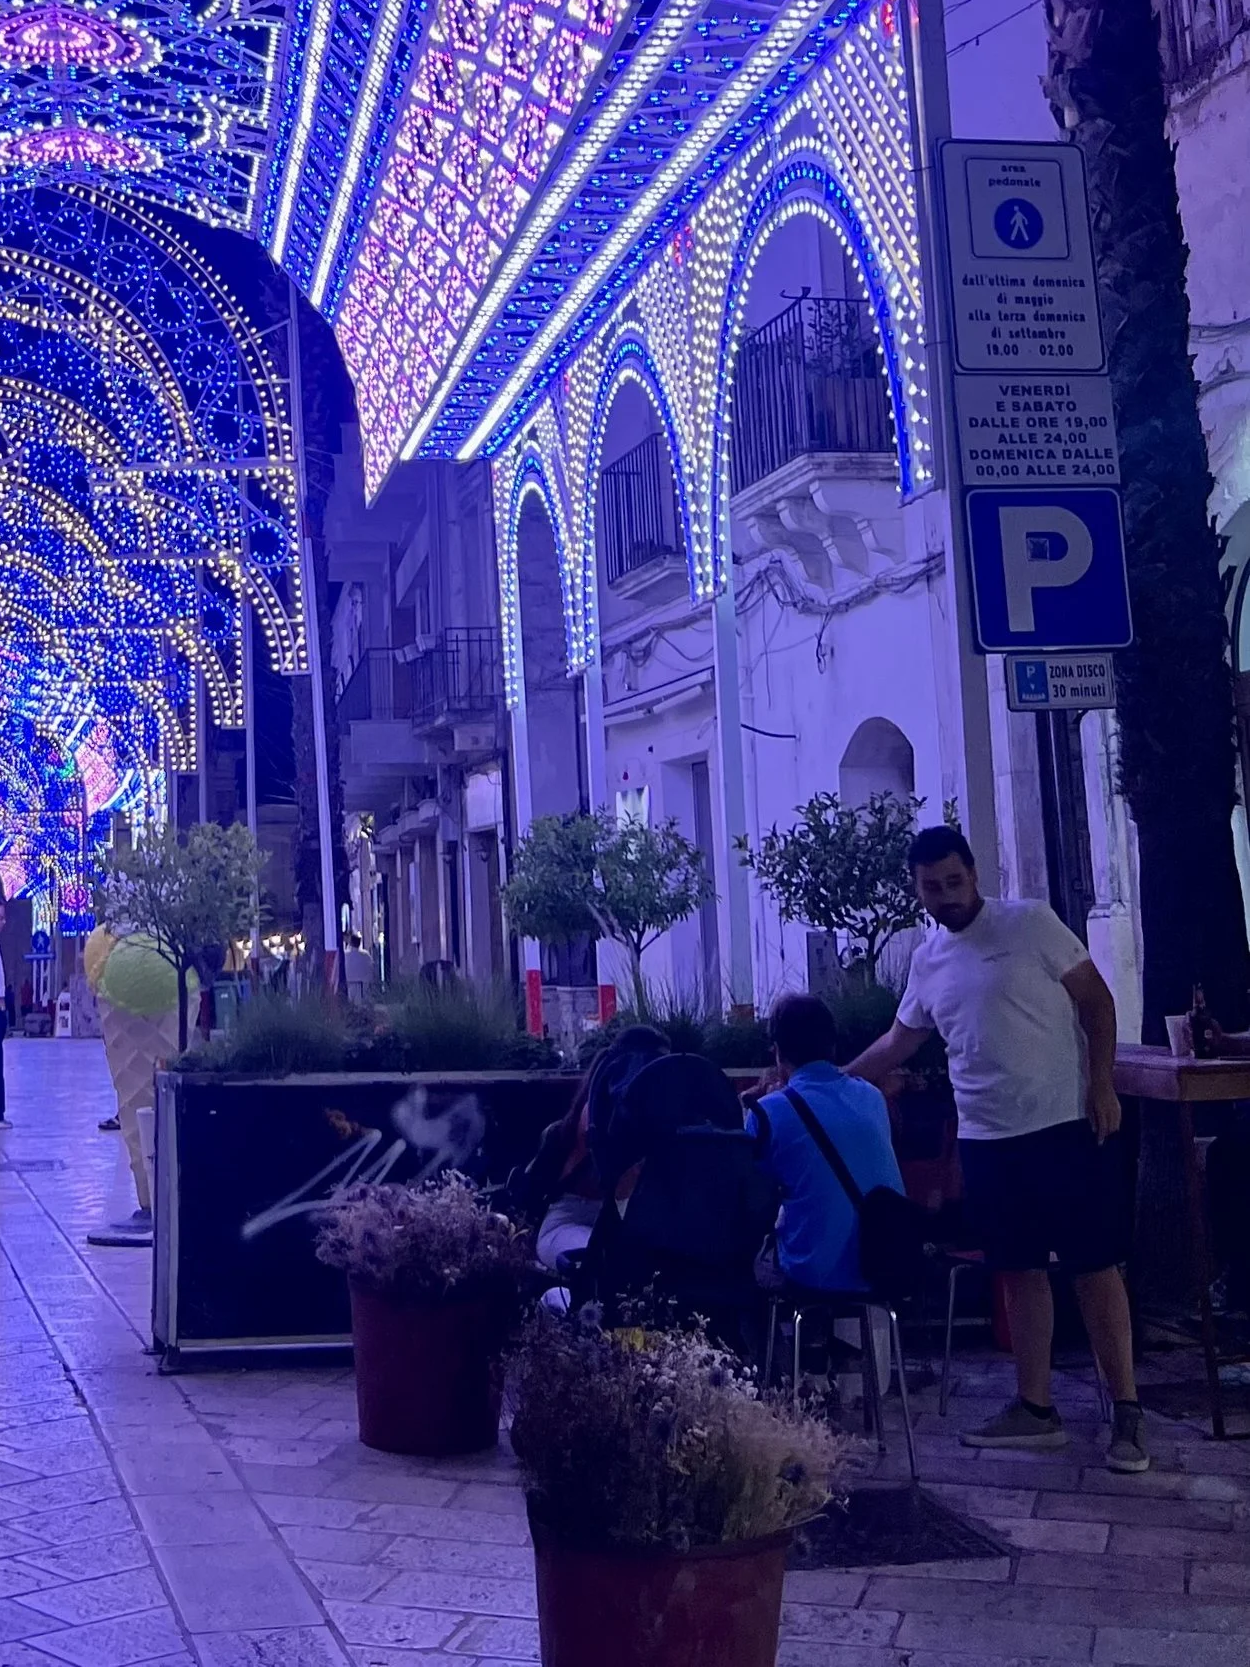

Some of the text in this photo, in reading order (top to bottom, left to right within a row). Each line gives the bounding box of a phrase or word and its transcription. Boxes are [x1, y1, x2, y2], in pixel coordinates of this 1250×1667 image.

[988, 176, 1041, 187] pedonale
[962, 274, 1086, 288] dall'ultima domenica
[997, 293, 1054, 307] di maggio
[968, 309, 1086, 323] alla terza domenica
[991, 327, 1066, 340] di settembre
[986, 344, 1019, 356] 19.00
[1039, 344, 1074, 357] 02.00
[999, 383, 1071, 396] VENERDÌ
[996, 401, 1077, 412] E SABATO
[969, 416, 1107, 430] DALLE ORE 19,00
[998, 432, 1087, 446] ALLE 24,00
[969, 448, 1114, 460] DOMENICA DALLE
[976, 464, 1115, 477] 00,00 ALLE 24,00
[999, 505, 1093, 632] P
[1026, 665, 1036, 678] P
[1049, 664, 1106, 678] ZONA DISCO
[1052, 684, 1067, 698] 30
[1070, 683, 1106, 697] minuti
